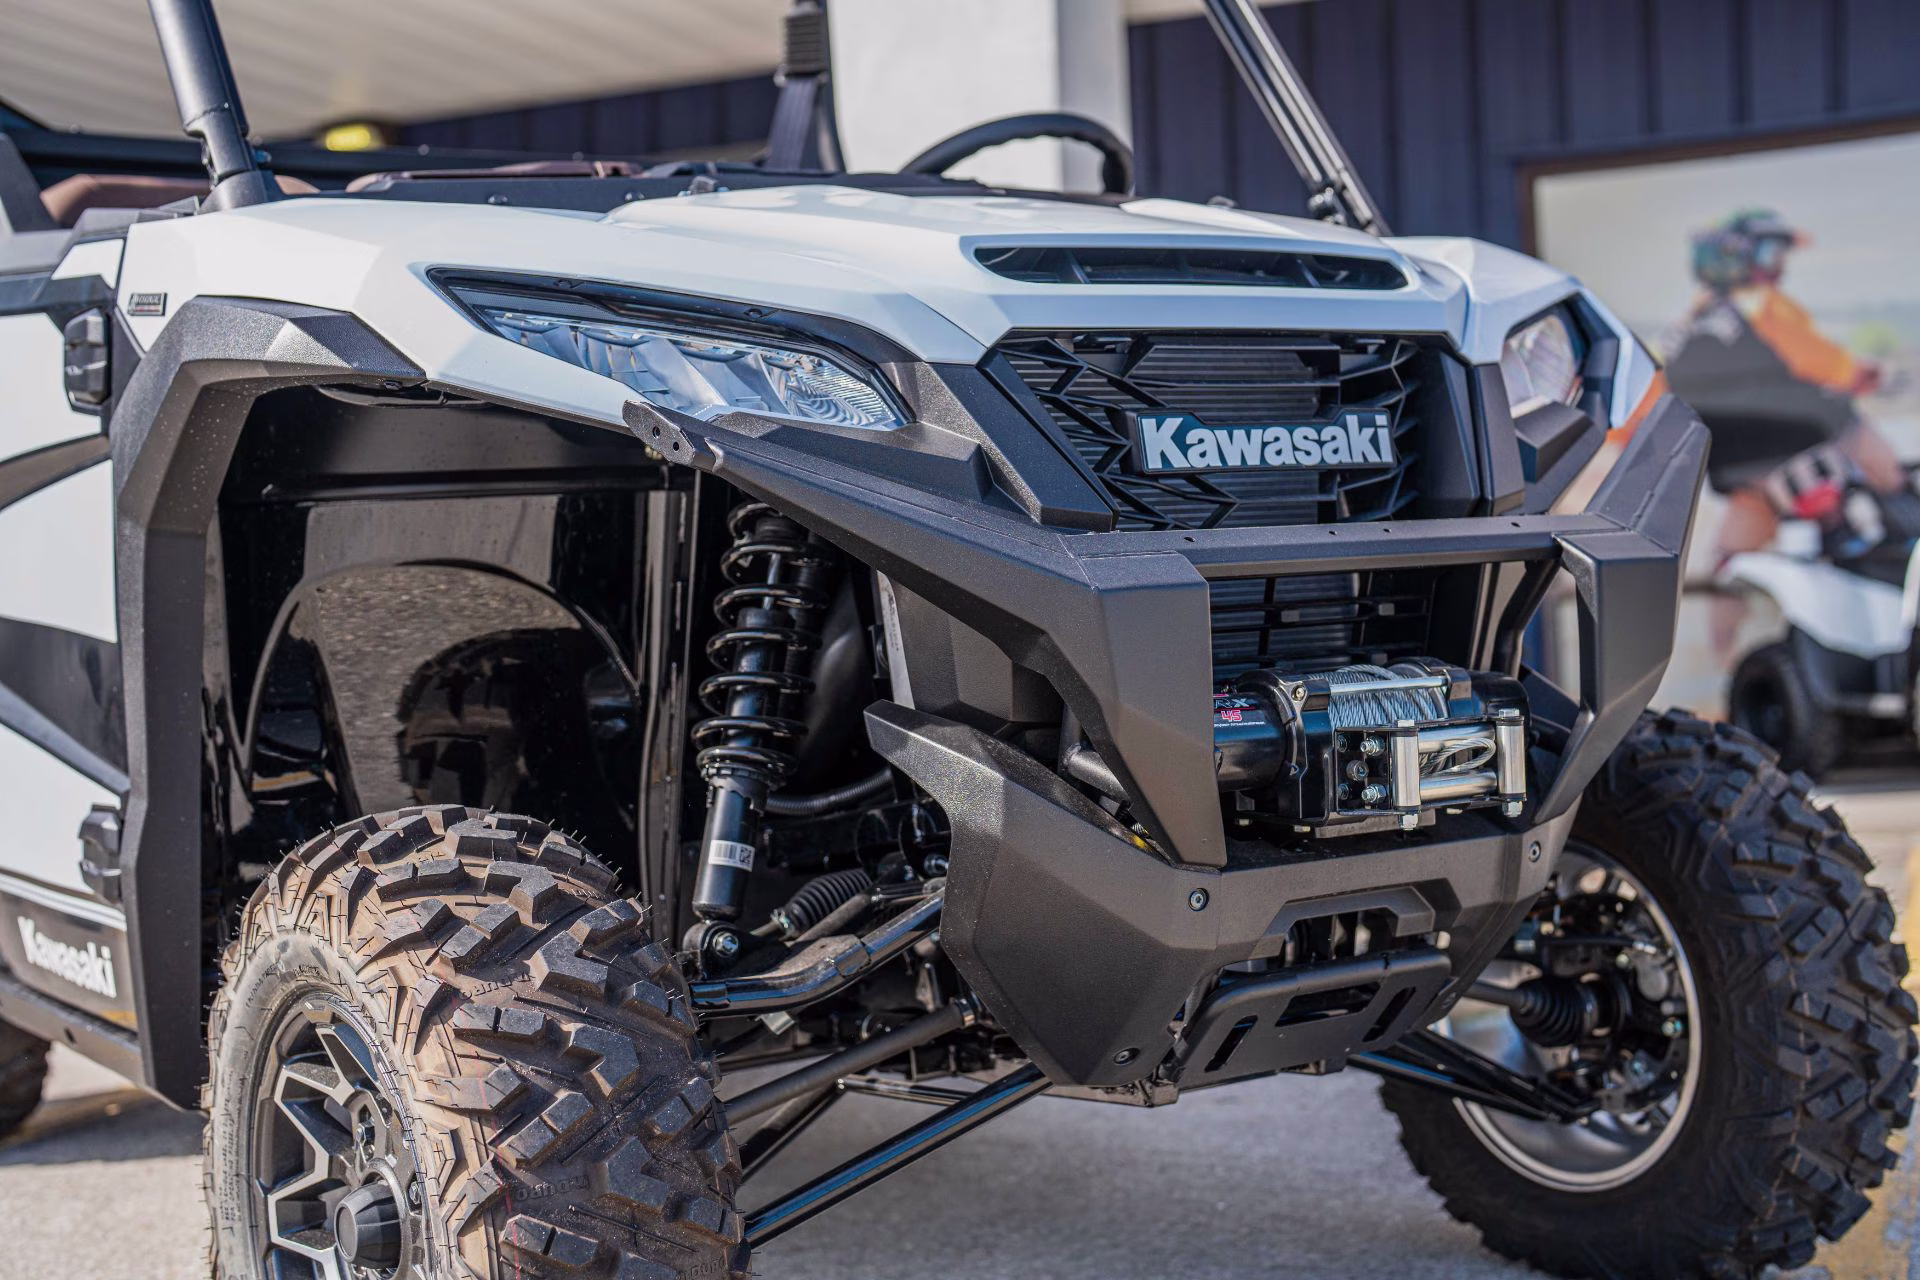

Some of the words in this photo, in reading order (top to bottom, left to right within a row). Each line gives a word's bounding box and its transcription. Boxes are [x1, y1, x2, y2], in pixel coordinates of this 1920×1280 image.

[1141, 414, 1394, 469] Kawasaki
[1214, 697, 1250, 709] RX
[1221, 709, 1243, 722] 45
[17, 916, 117, 998] Kawasaki
